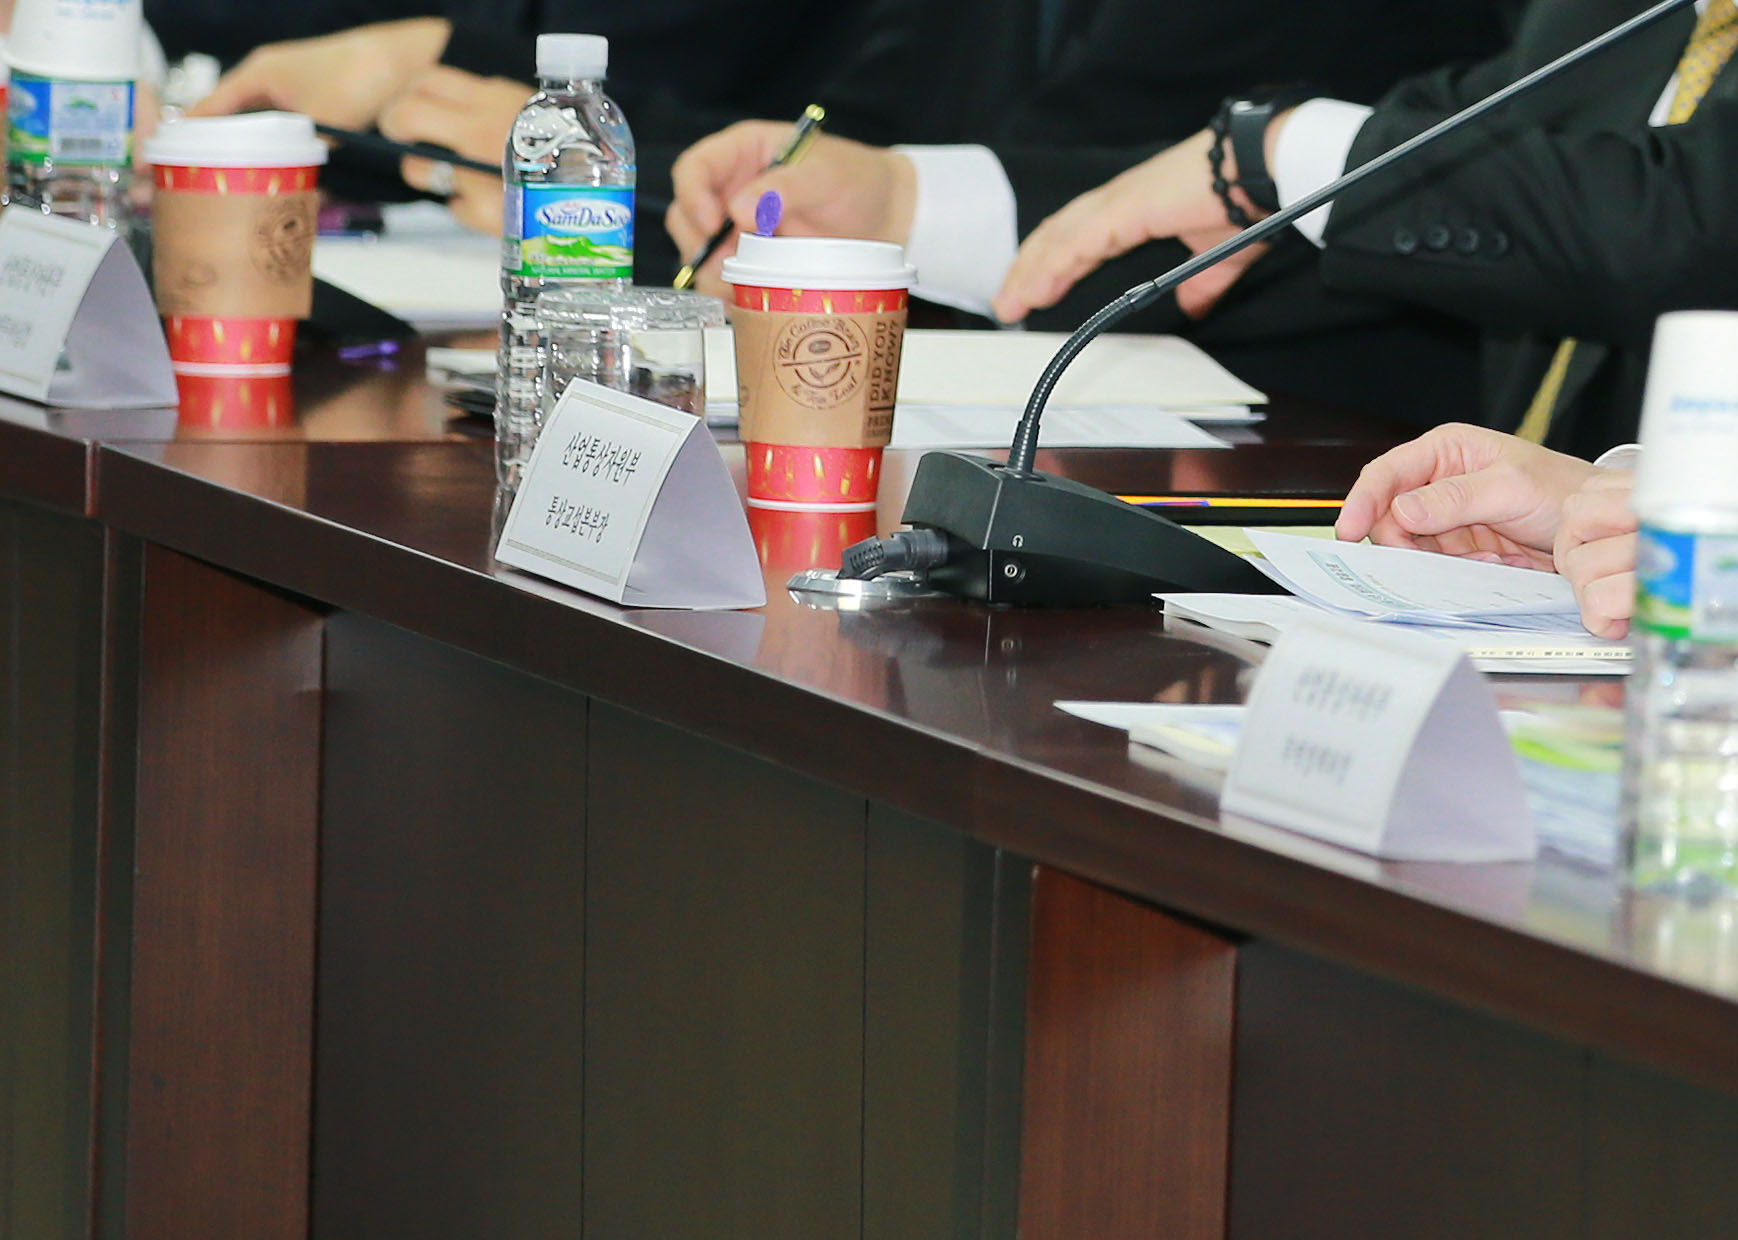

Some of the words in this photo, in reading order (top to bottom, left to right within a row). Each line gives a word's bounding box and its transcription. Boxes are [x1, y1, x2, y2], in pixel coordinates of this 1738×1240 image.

[874, 321, 887, 361] YOU
[870, 367, 882, 401] DID
[563, 432, 642, 486] 산업통상자원부
[545, 495, 610, 544] 통상교섭본부장
